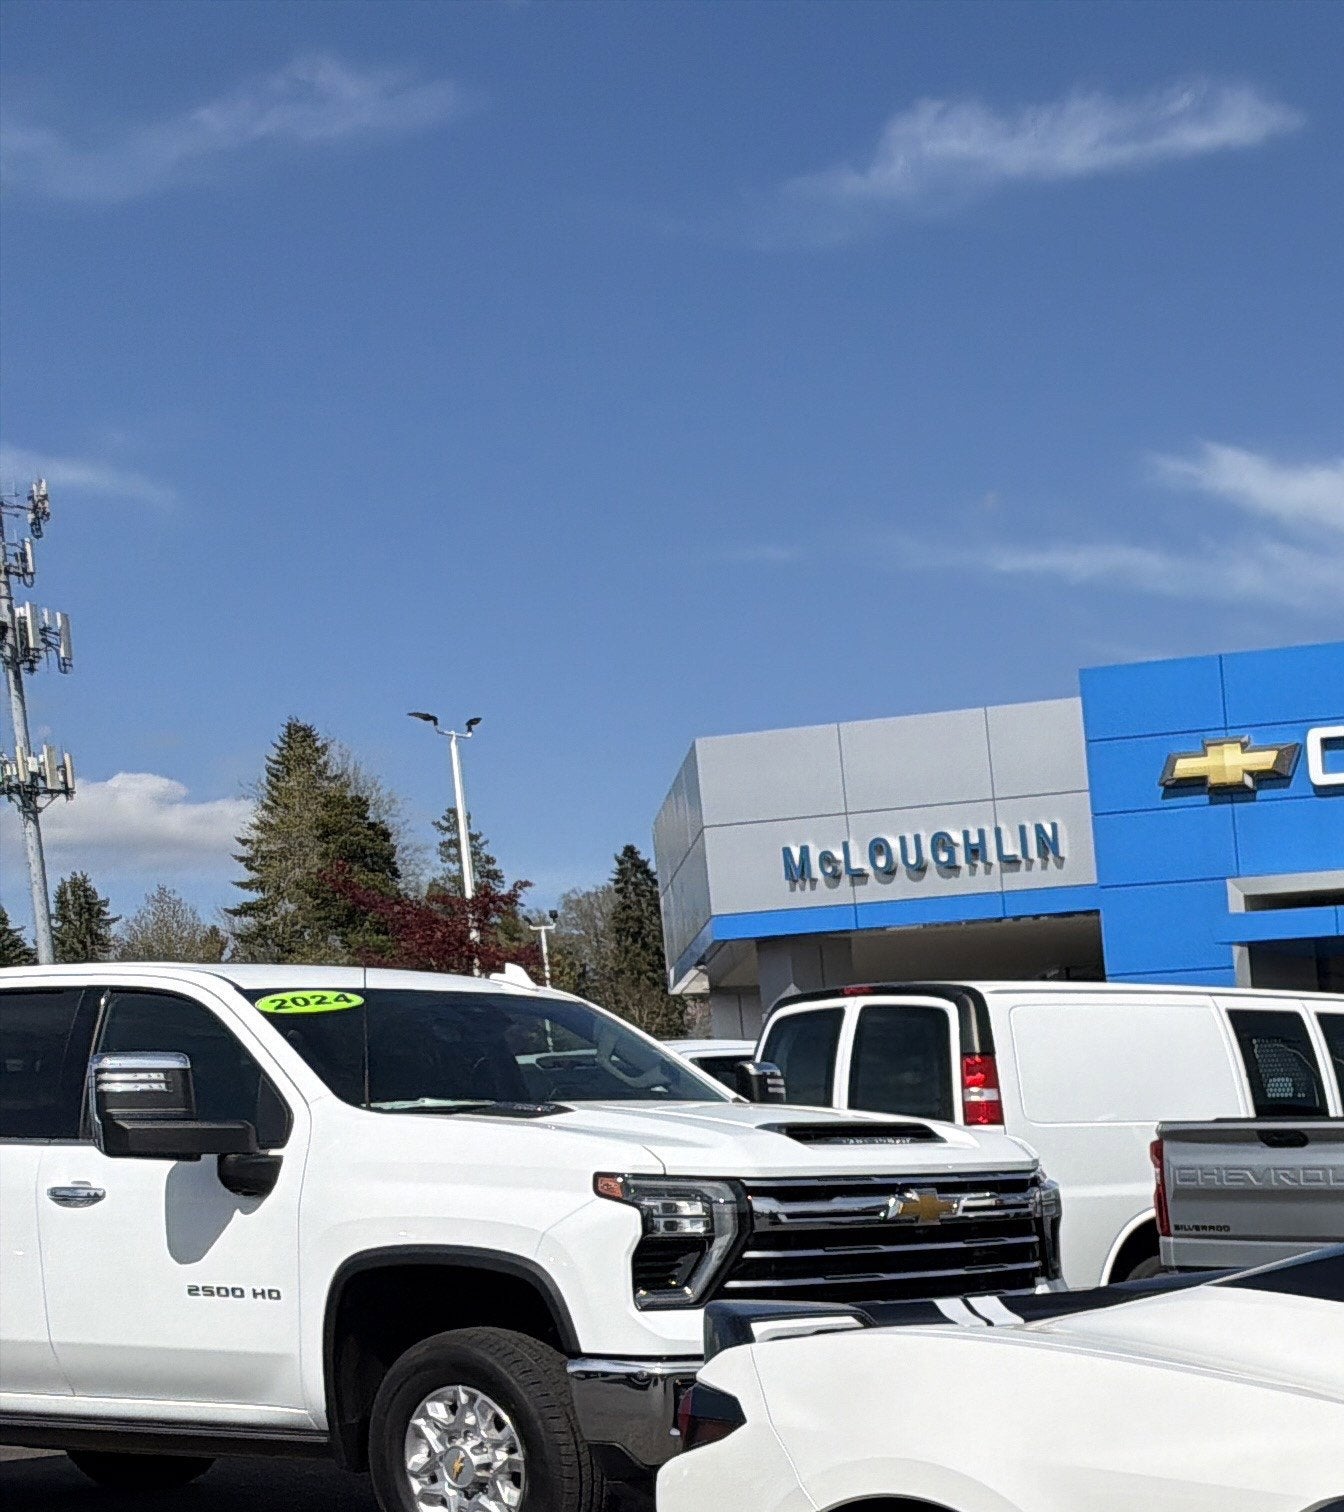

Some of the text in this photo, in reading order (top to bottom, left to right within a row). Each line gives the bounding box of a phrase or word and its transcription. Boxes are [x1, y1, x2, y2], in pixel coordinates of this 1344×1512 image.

[782, 822, 1060, 882] McLOUGHLIN
[269, 993, 354, 1010] 2024
[187, 1284, 283, 1301] 2500 HD
